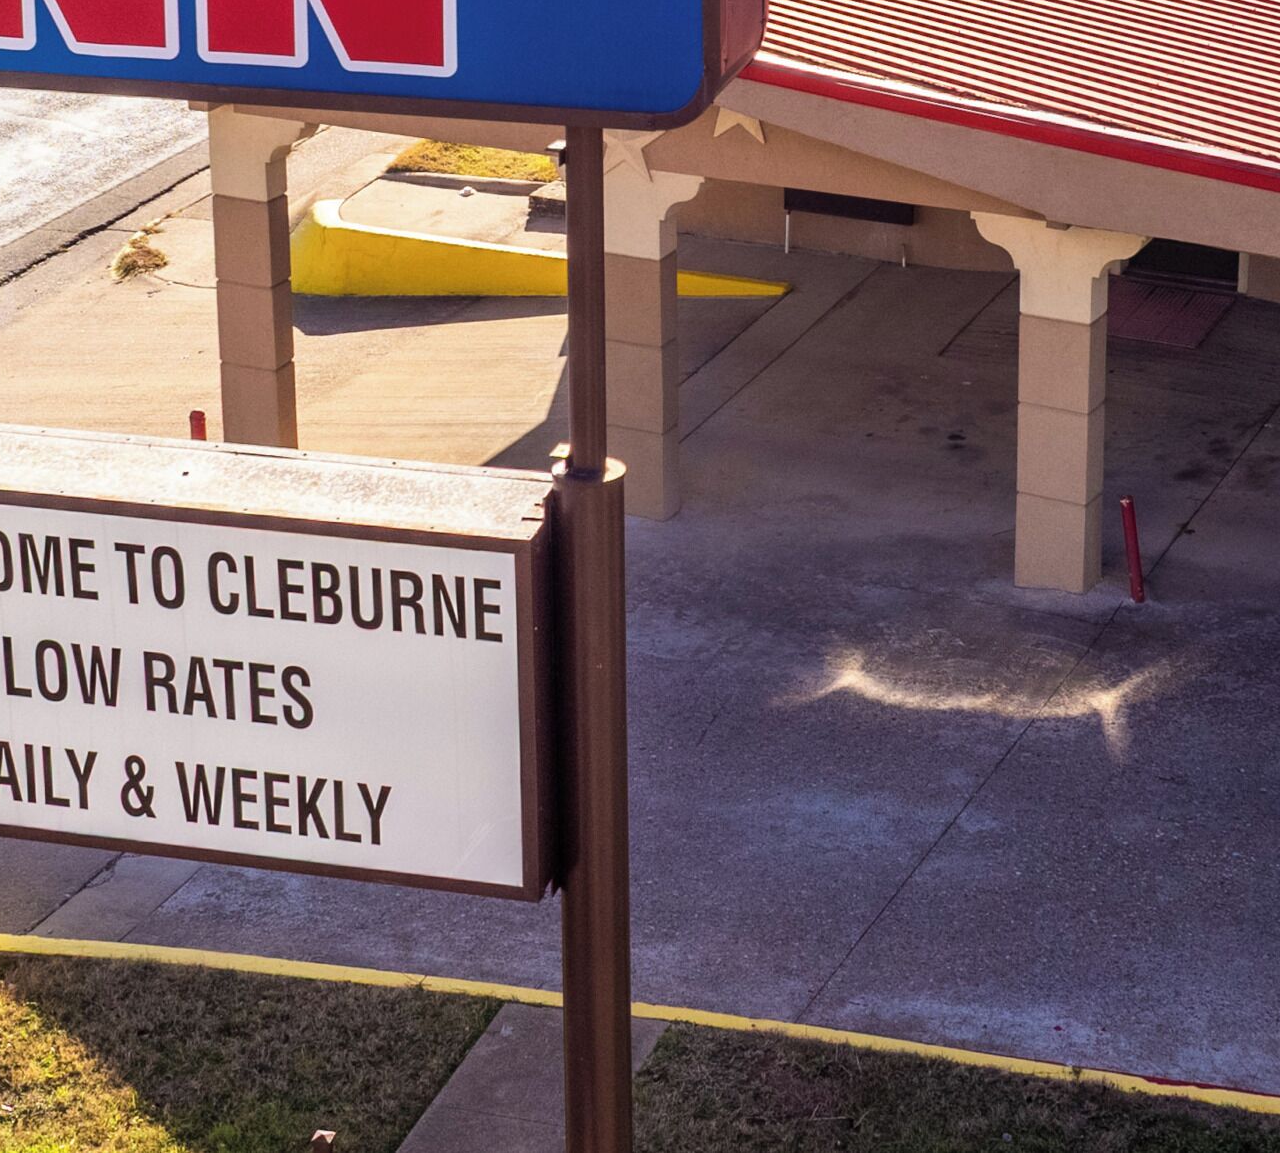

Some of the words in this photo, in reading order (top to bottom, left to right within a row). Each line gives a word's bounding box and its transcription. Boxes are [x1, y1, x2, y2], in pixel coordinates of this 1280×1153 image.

[114, 542, 186, 610] TO
[207, 551, 504, 643] CLEBURNE
[1, 635, 122, 708] LOW
[143, 650, 314, 729] RATES
[120, 754, 157, 819] &
[174, 761, 393, 845] WEEKLY
